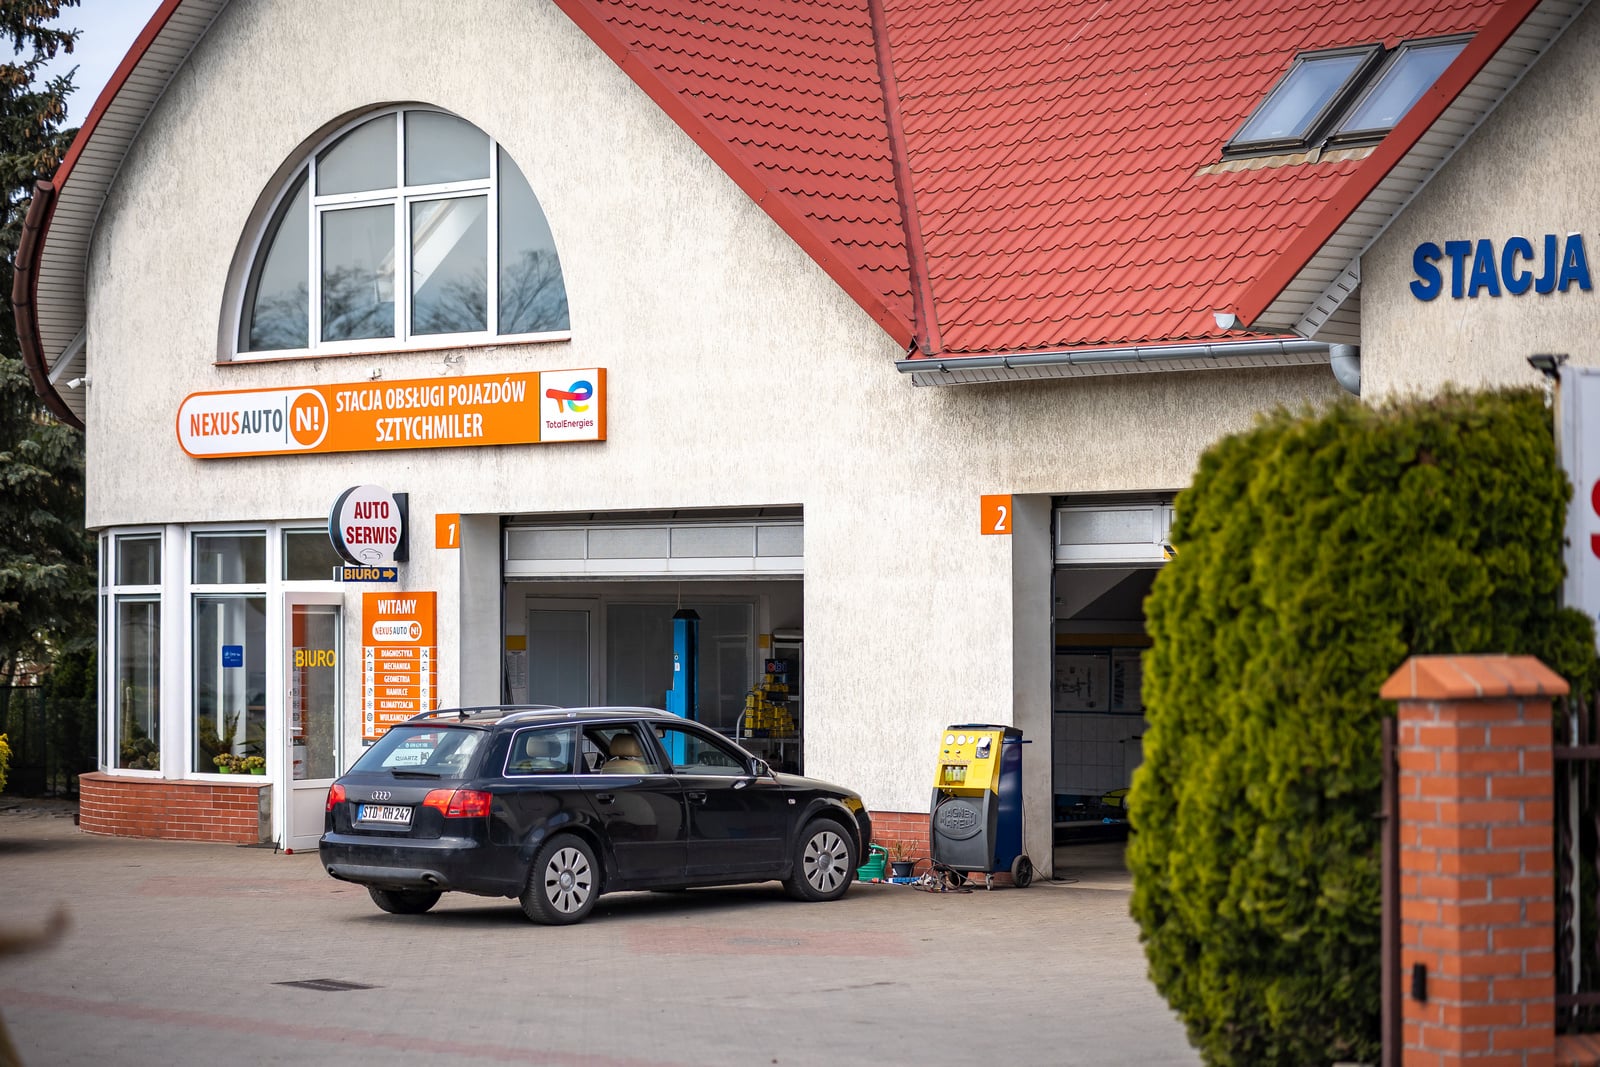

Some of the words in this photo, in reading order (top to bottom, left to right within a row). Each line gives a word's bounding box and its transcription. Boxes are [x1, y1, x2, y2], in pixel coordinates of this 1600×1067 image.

[1409, 232, 1592, 302] STACJA
[336, 389, 383, 413] STACJA
[385, 385, 444, 410] OBSŁUGI
[448, 377, 526, 407] POJAZDÓW
[295, 406, 320, 432] N!
[375, 413, 483, 442] SZTYCHMILER
[545, 419, 594, 430] TotalEnergies
[354, 501, 389, 519] AUTO
[994, 505, 1007, 531] 2
[346, 526, 397, 545] SERWIS
[448, 523, 456, 546] 1
[343, 568, 380, 579] BIURO
[377, 599, 417, 615] WITAMY
[295, 649, 336, 668] BIURO
[381, 649, 414, 658] DIAGNOSTYKA
[383, 662, 411, 670] MECHANIKA
[363, 806, 378, 819] STD
[383, 807, 394, 819] RH
[394, 808, 411, 820] 247
